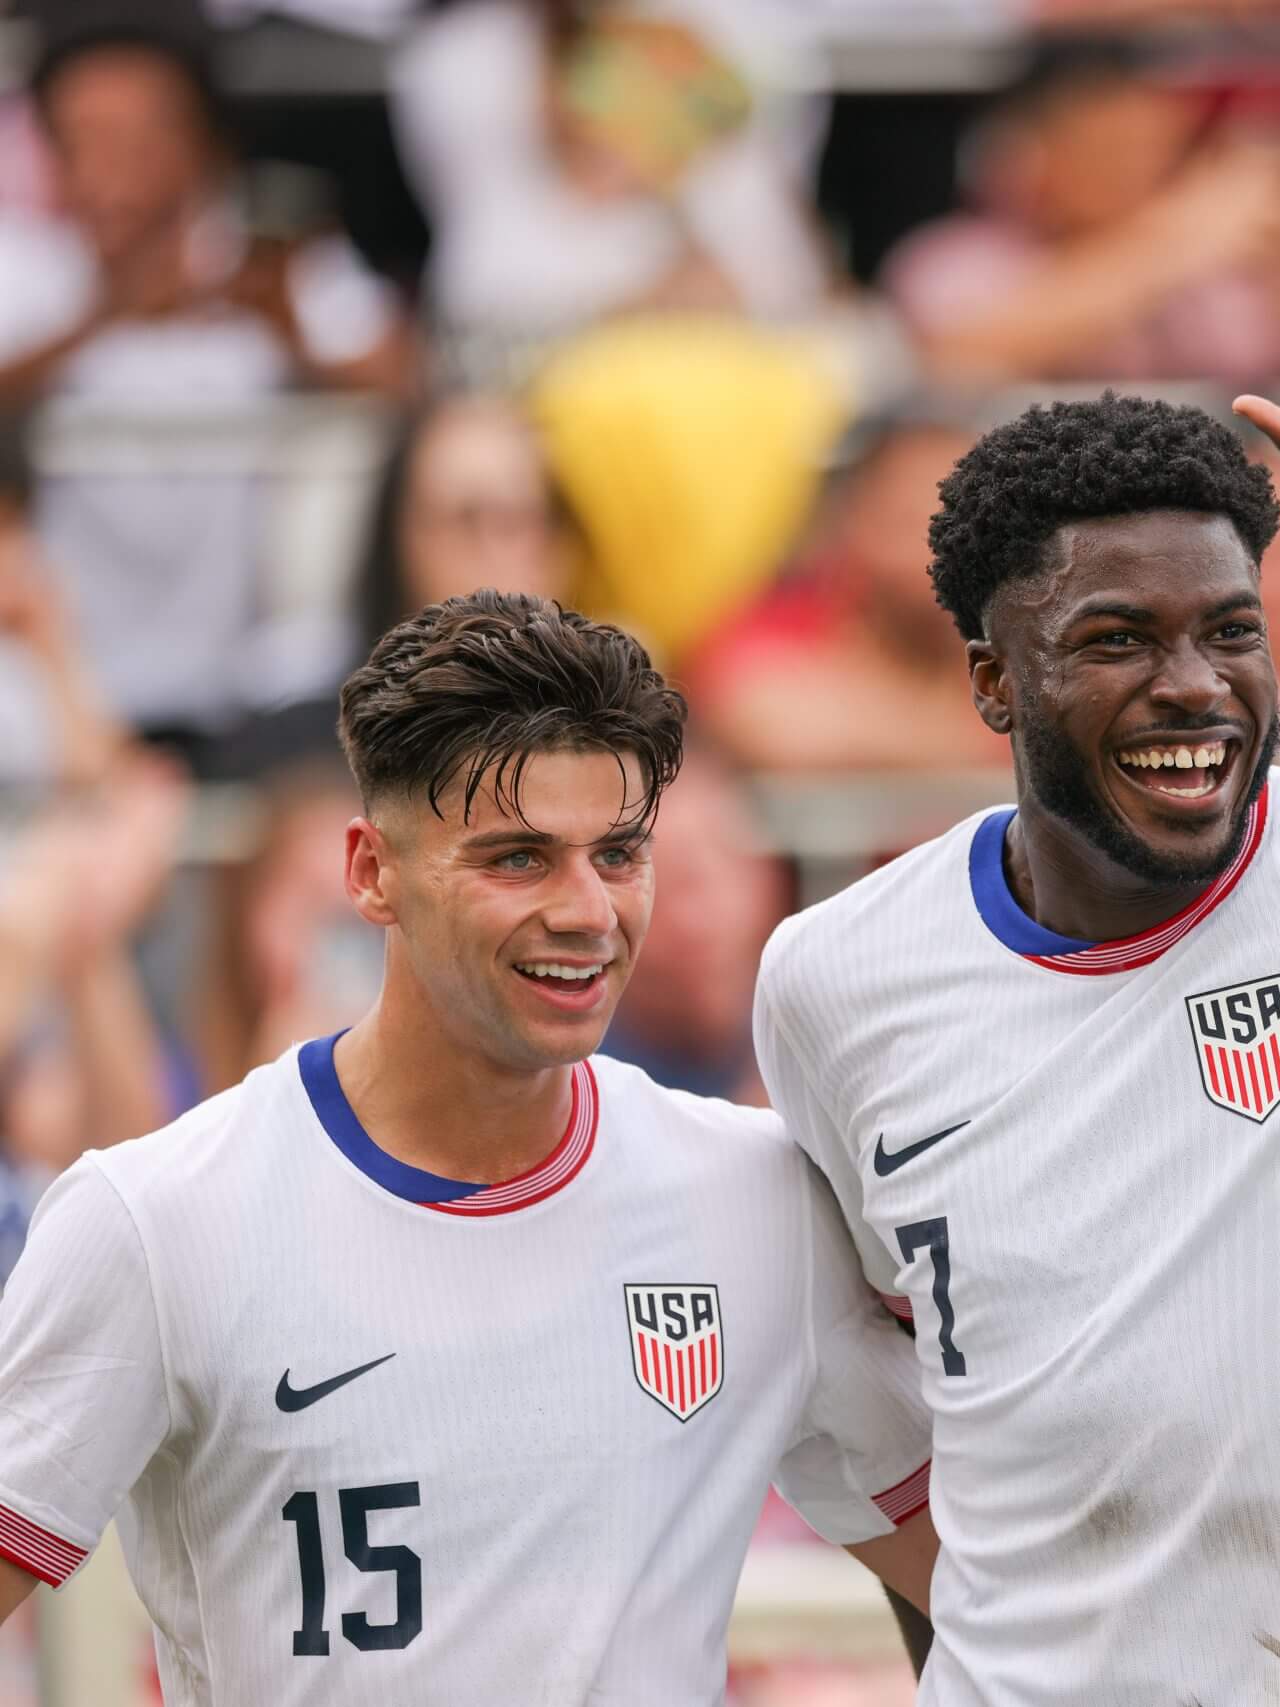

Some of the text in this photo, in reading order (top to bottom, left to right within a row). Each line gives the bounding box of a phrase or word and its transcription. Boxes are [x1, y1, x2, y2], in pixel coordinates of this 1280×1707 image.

[633, 1293, 713, 1340] USA
[894, 1216, 967, 1377] 7
[281, 1481, 423, 1658] 15
